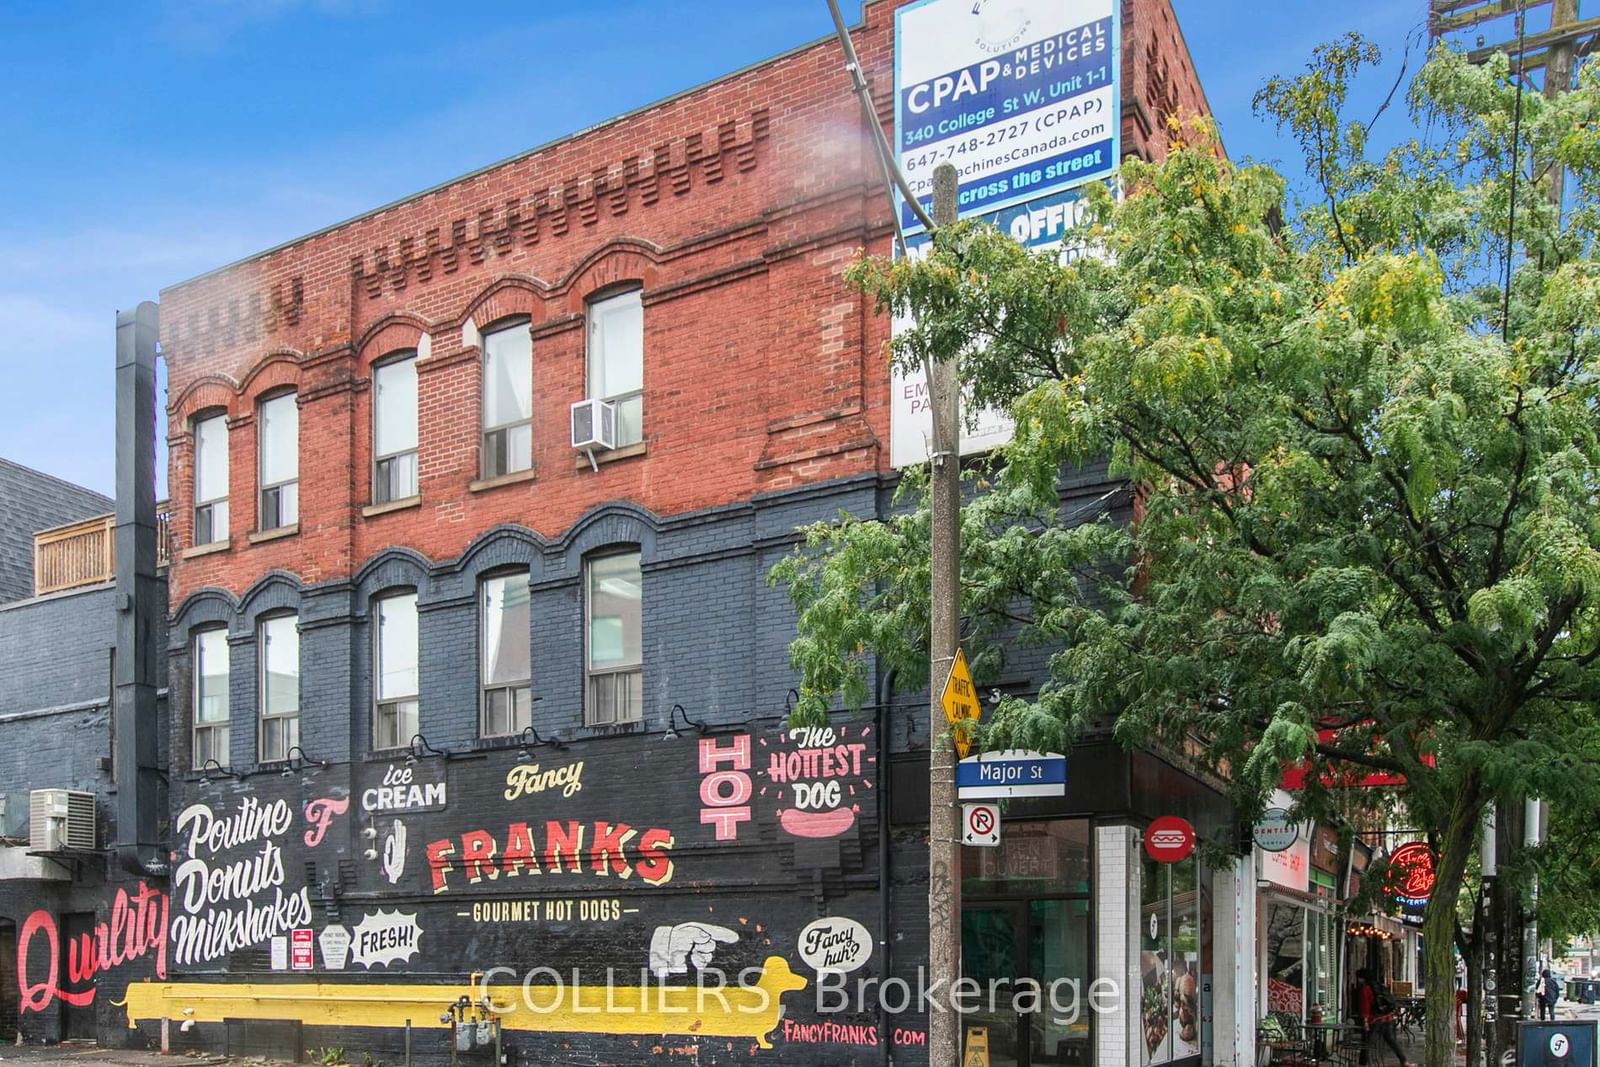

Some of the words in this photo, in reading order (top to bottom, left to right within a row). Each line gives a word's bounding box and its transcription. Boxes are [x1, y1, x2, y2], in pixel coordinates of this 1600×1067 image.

[908, 60, 1001, 114] CPAP
[1002, 64, 1012, 77] &
[1015, 22, 1106, 61] MEDICAL
[1015, 38, 1106, 80] DEVICES
[905, 124, 934, 146] 340
[938, 105, 995, 135] College
[1003, 97, 1020, 113] St
[1023, 88, 1046, 107] W,
[1049, 76, 1082, 98] Unit
[1086, 66, 1107, 87] 1-1
[906, 121, 1029, 171] 647-748-2727
[1035, 97, 1103, 132] (CPAP)
[957, 179, 1008, 205] cross
[1011, 165, 1042, 190] the
[1045, 149, 1102, 179] street
[952, 676, 971, 697] TRAFFIC
[789, 726, 836, 748] The
[383, 764, 413, 786] ice
[504, 761, 584, 801] Fancy
[767, 743, 867, 783] HOTTEST
[980, 763, 1023, 783] Major
[1030, 765, 1043, 779] St
[362, 782, 447, 813] CREAM
[698, 734, 752, 840] HOT
[791, 780, 841, 809] DOG
[1008, 787, 1013, 795] 1
[177, 797, 292, 861] Poutine
[176, 840, 285, 915] Donuts
[425, 820, 676, 895] FRANKS
[171, 887, 313, 966] Milkshakes
[473, 902, 540, 922] GOURMET
[545, 901, 573, 921] HOT
[580, 899, 621, 922] DOGS
[17, 880, 170, 1015] Quality
[360, 925, 414, 958] FRESH!
[804, 926, 854, 955] Fancy
[823, 943, 861, 967] huh?
